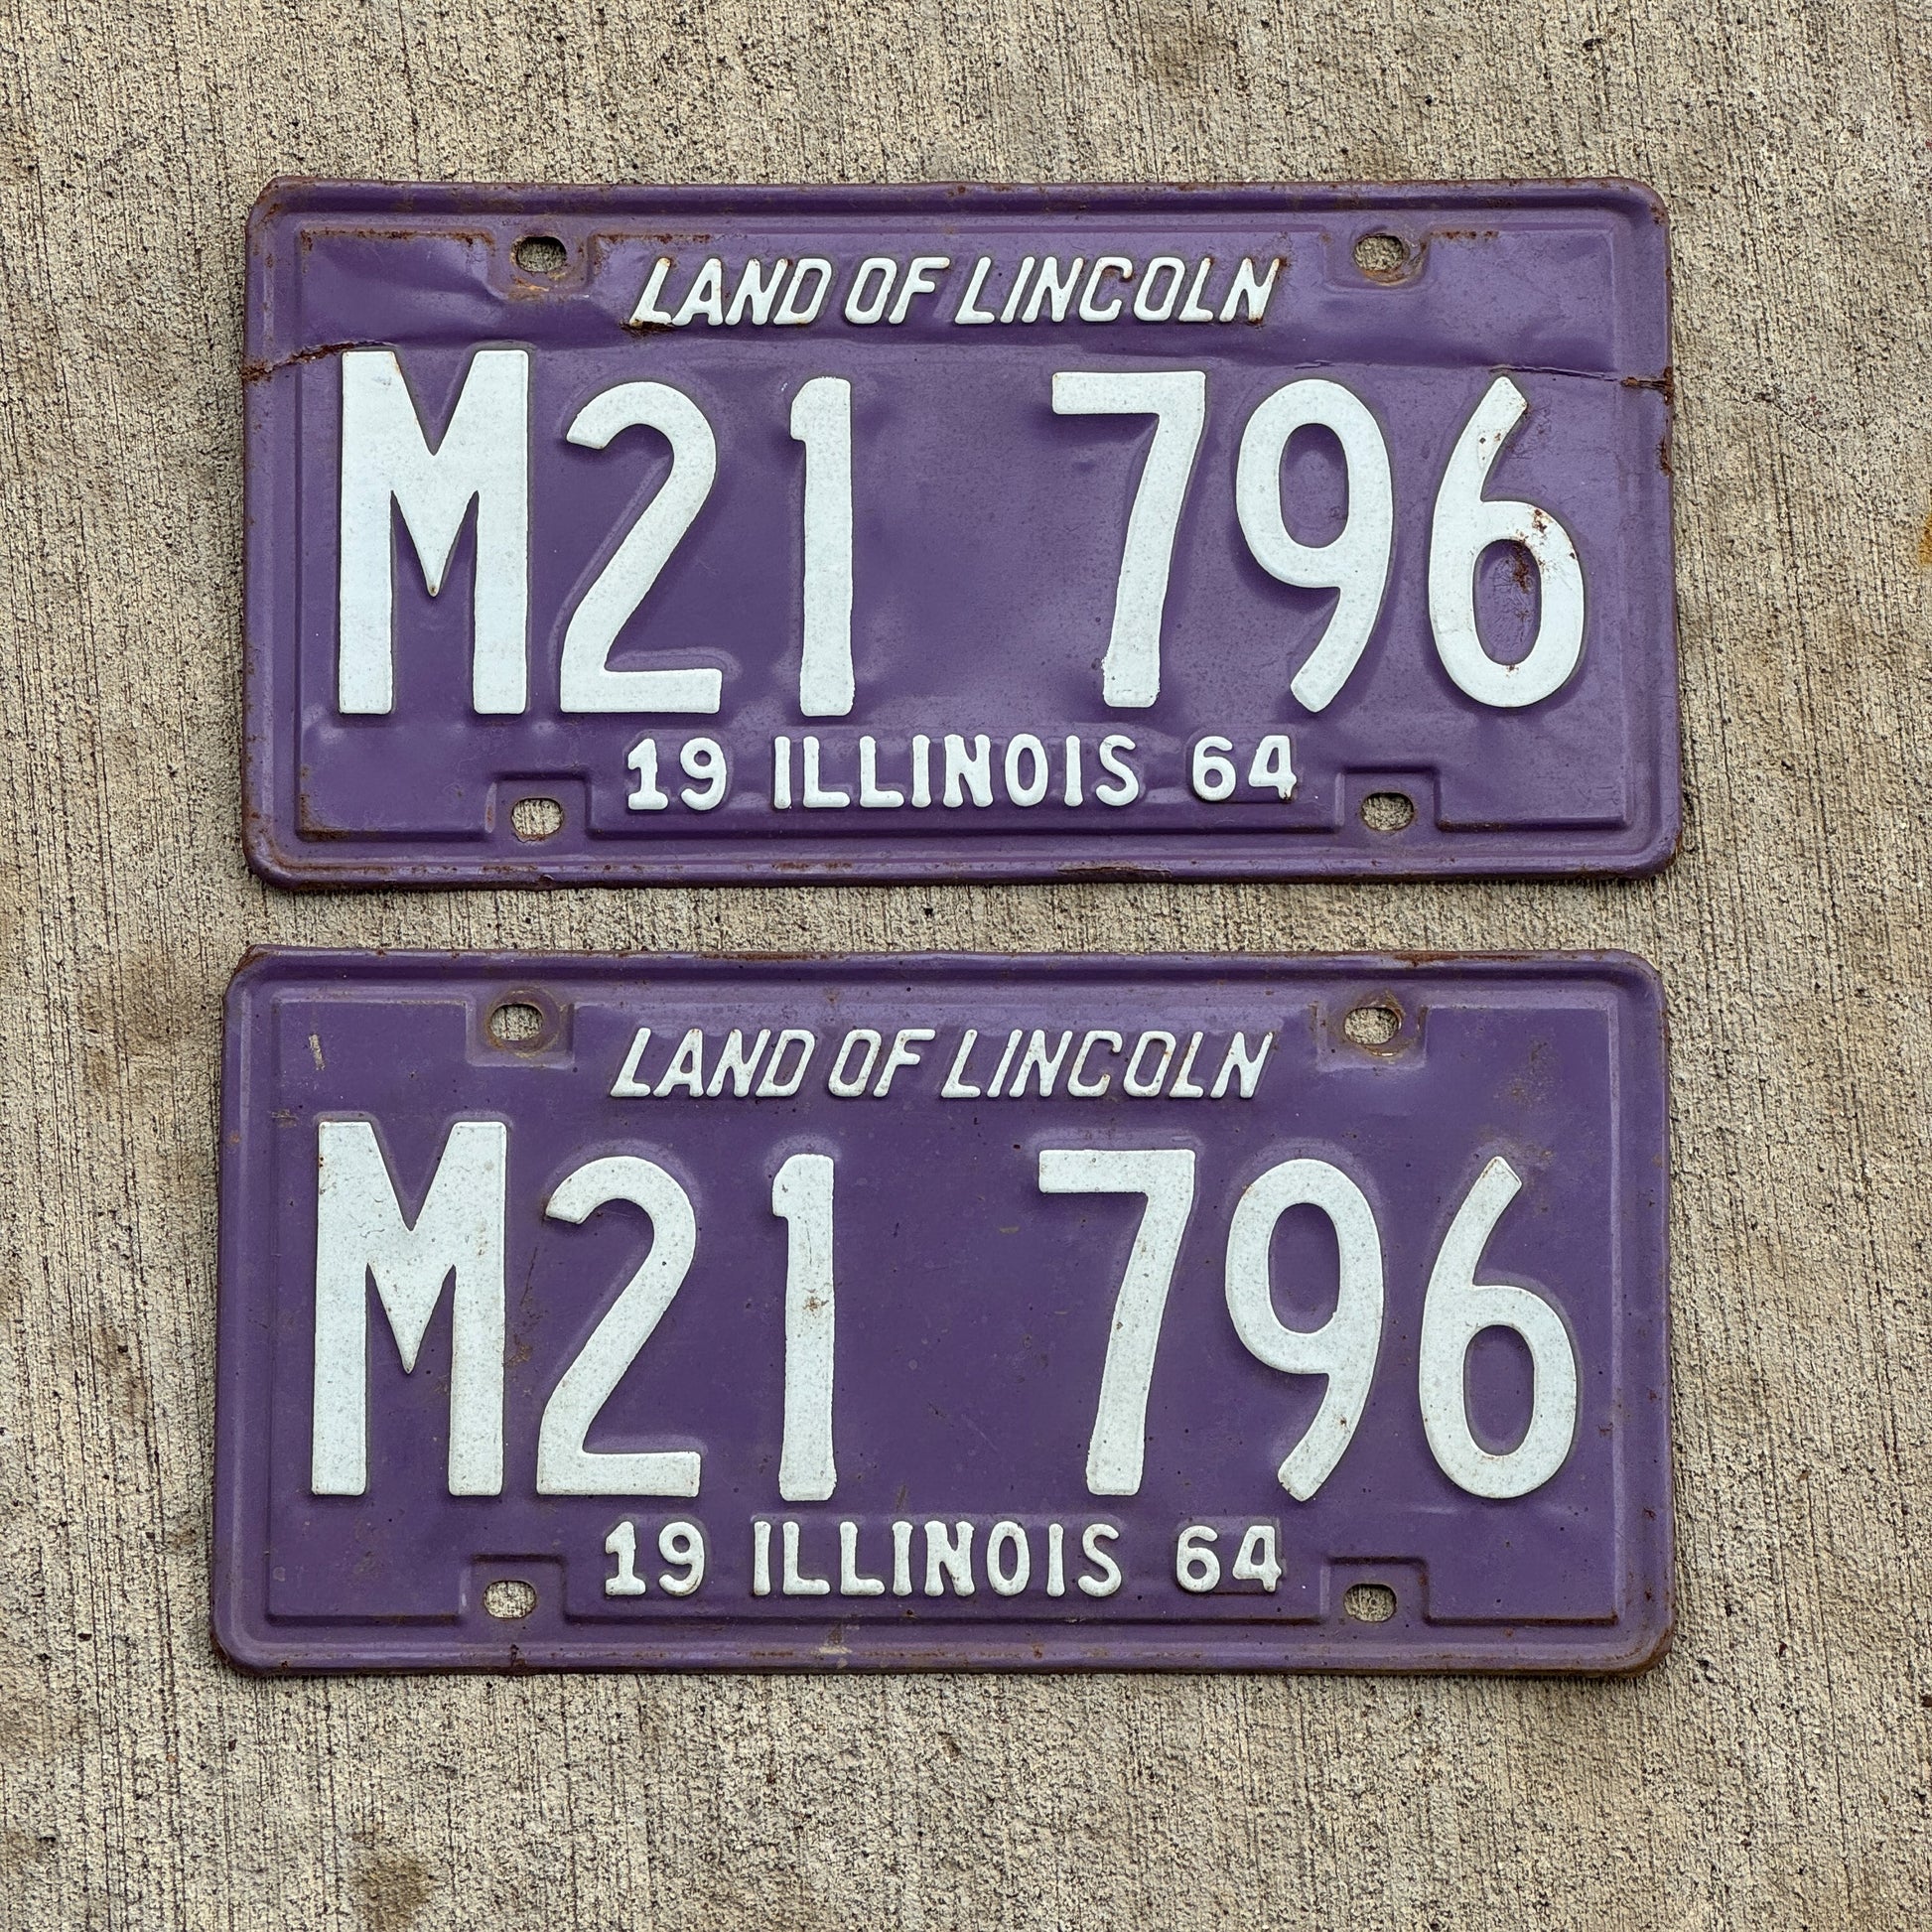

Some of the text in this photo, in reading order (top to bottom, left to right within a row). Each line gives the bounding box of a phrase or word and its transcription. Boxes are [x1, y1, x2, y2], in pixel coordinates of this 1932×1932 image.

[628, 256, 1281, 326] LAND OF LINCOLN
[339, 349, 1585, 717] M21 796
[627, 733, 1298, 810] 19 ILLINOIS 64
[611, 1027, 1274, 1099] LAND OF LINCOLN
[312, 1121, 1578, 1501] M21 796
[605, 1520, 1283, 1596] 19 ILLINOIS 64
